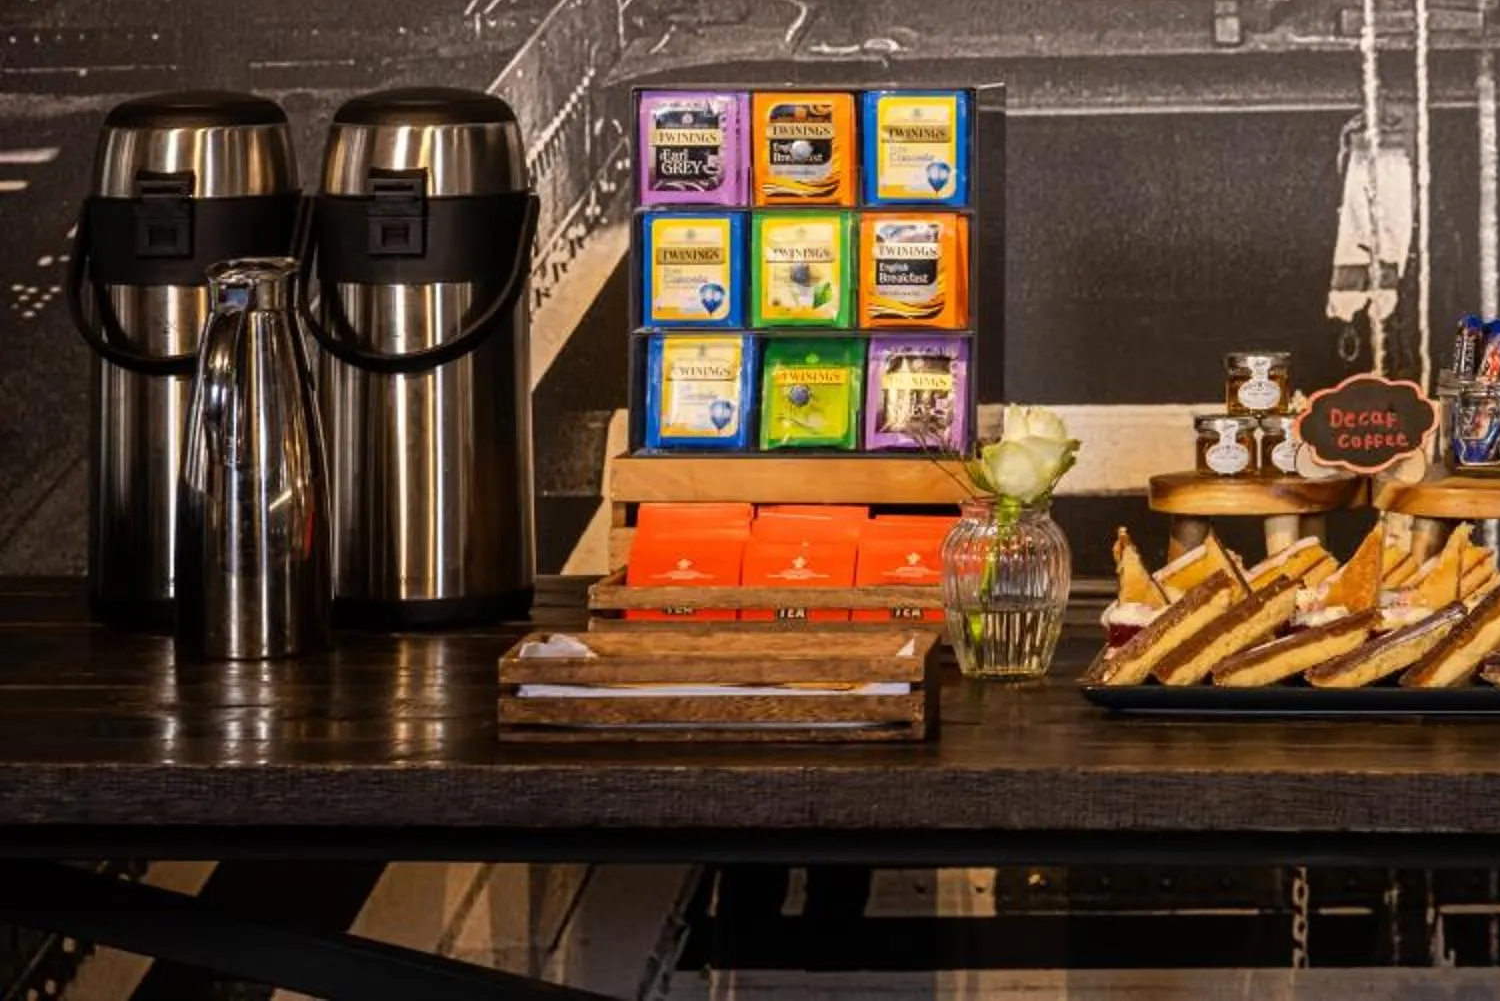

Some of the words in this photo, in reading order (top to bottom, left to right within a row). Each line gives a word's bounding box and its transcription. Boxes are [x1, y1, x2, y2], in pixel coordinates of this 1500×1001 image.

[773, 125, 831, 136] TWININGS
[888, 126, 946, 138] TWININGS
[658, 133, 717, 144] TWININGS
[661, 160, 703, 175] GREY
[663, 250, 720, 261] TWININGS
[879, 246, 938, 257] TWININGS
[879, 273, 929, 284] Breakfast
[779, 608, 805, 619] TEA
